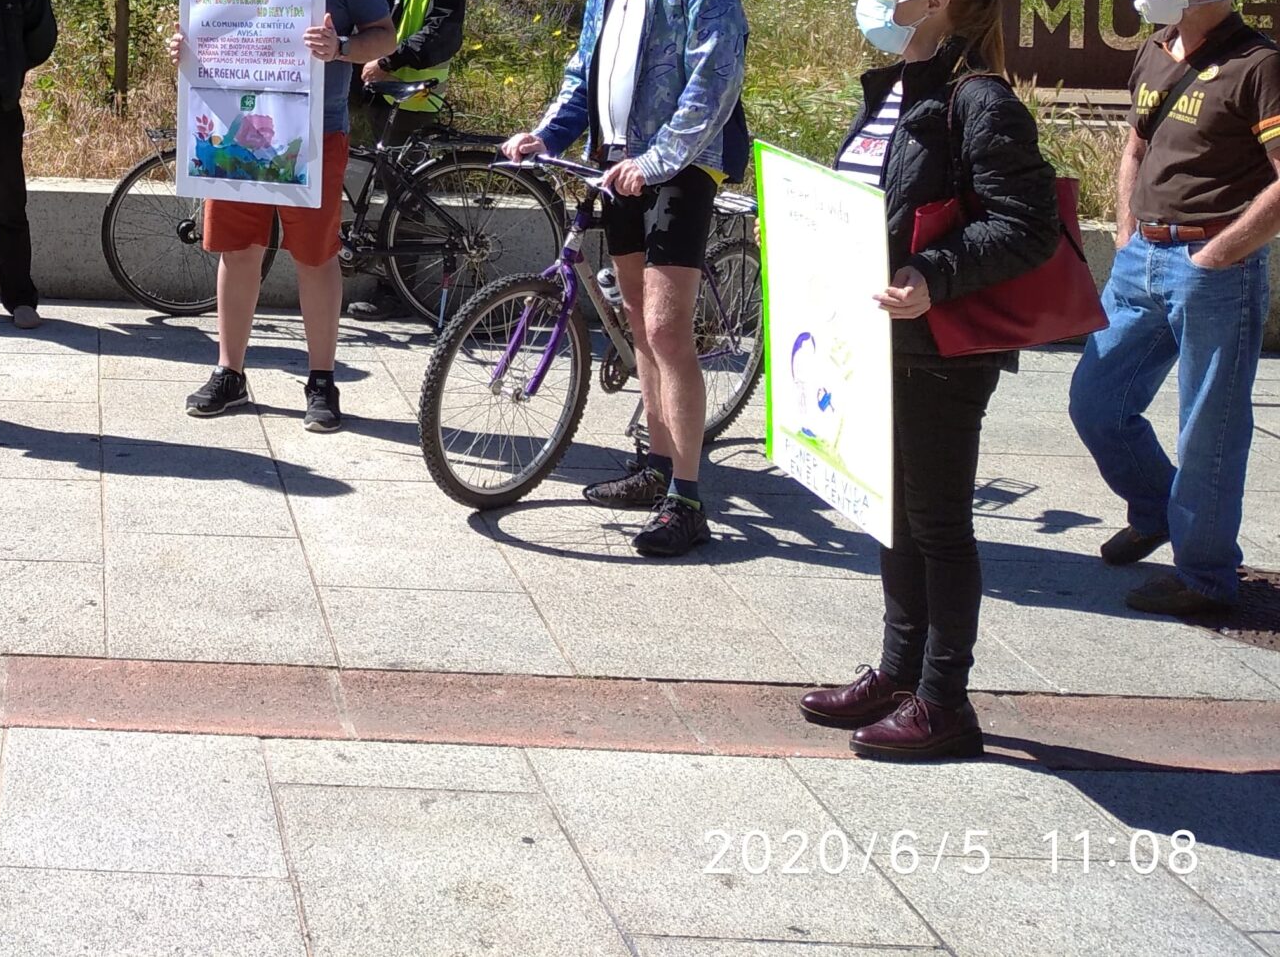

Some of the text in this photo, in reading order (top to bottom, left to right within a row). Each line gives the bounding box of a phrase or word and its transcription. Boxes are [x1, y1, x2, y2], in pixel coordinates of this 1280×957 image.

[211, 21, 253, 29] COMUNIDAD
[241, 36, 255, 44] PARA
[255, 36, 282, 44] REVERTIR
[256, 50, 275, 58] TARDE
[235, 57, 260, 65] MEDIDAS
[278, 58, 296, 66] PARAR
[198, 66, 302, 83] EMERGENCIA CLIMÁTICA
[806, 465, 819, 491] EL
